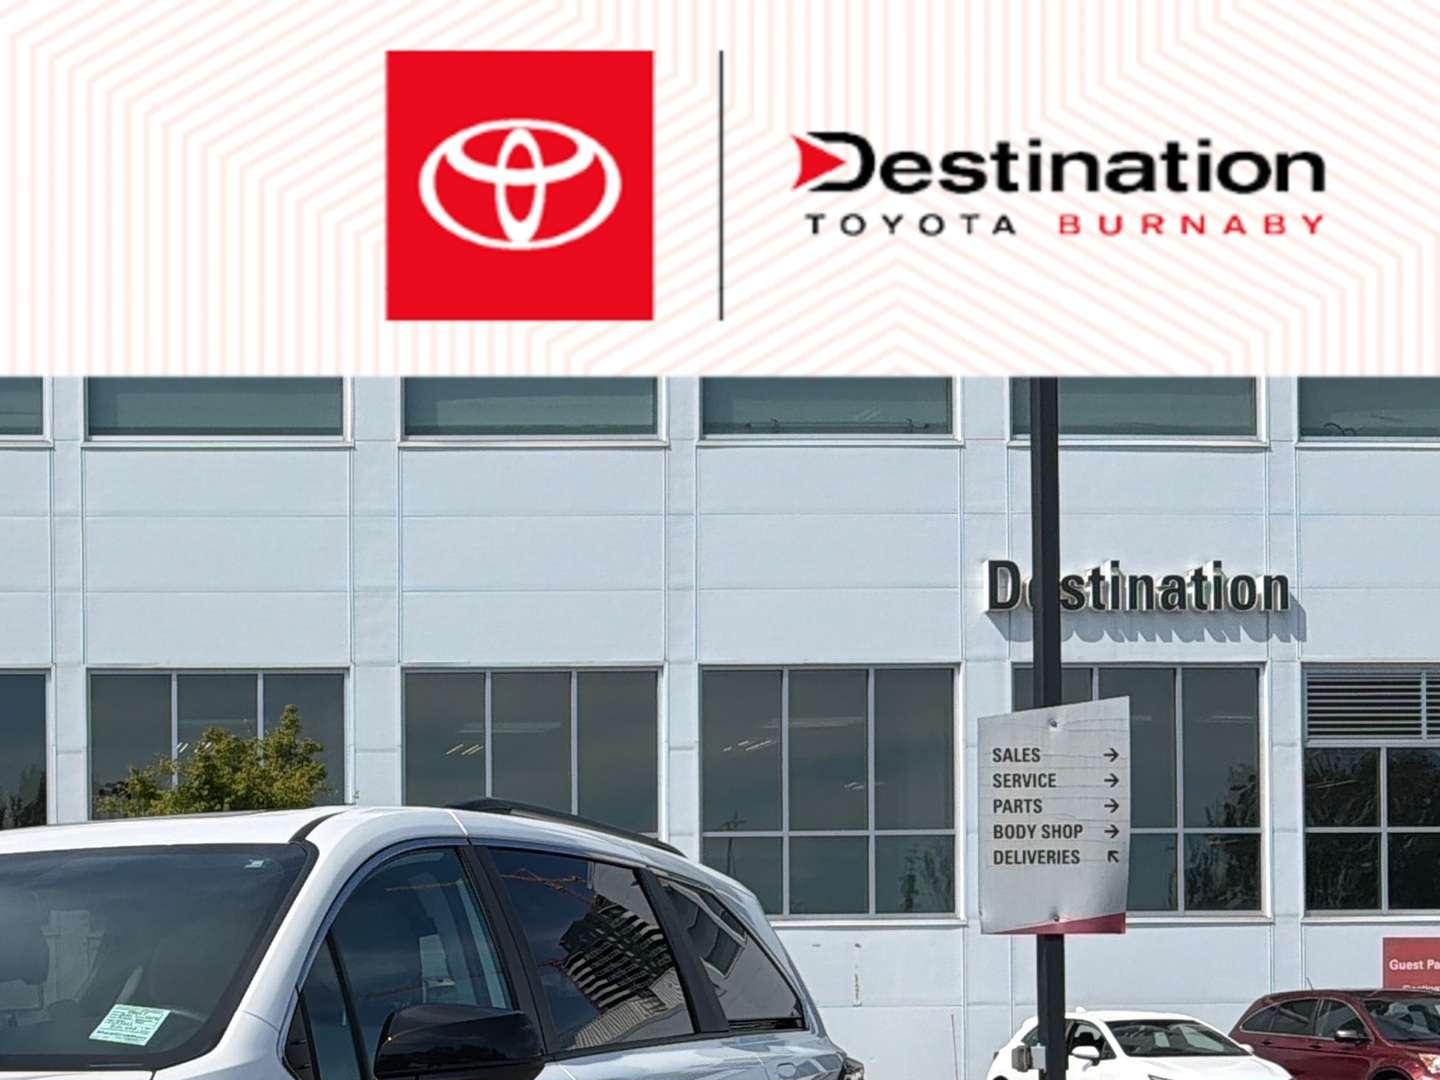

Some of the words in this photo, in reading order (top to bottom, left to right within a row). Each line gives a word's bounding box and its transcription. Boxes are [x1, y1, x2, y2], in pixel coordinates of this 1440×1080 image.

[992, 747, 1041, 763] SALES
[992, 772, 1057, 789] SERVICE
[993, 798, 1043, 814] PARTS
[993, 824, 1037, 840] BODY
[1041, 823, 1083, 839] SHOP
[993, 849, 1081, 865] DELIVERIES
[1389, 958, 1424, 971] Guest
